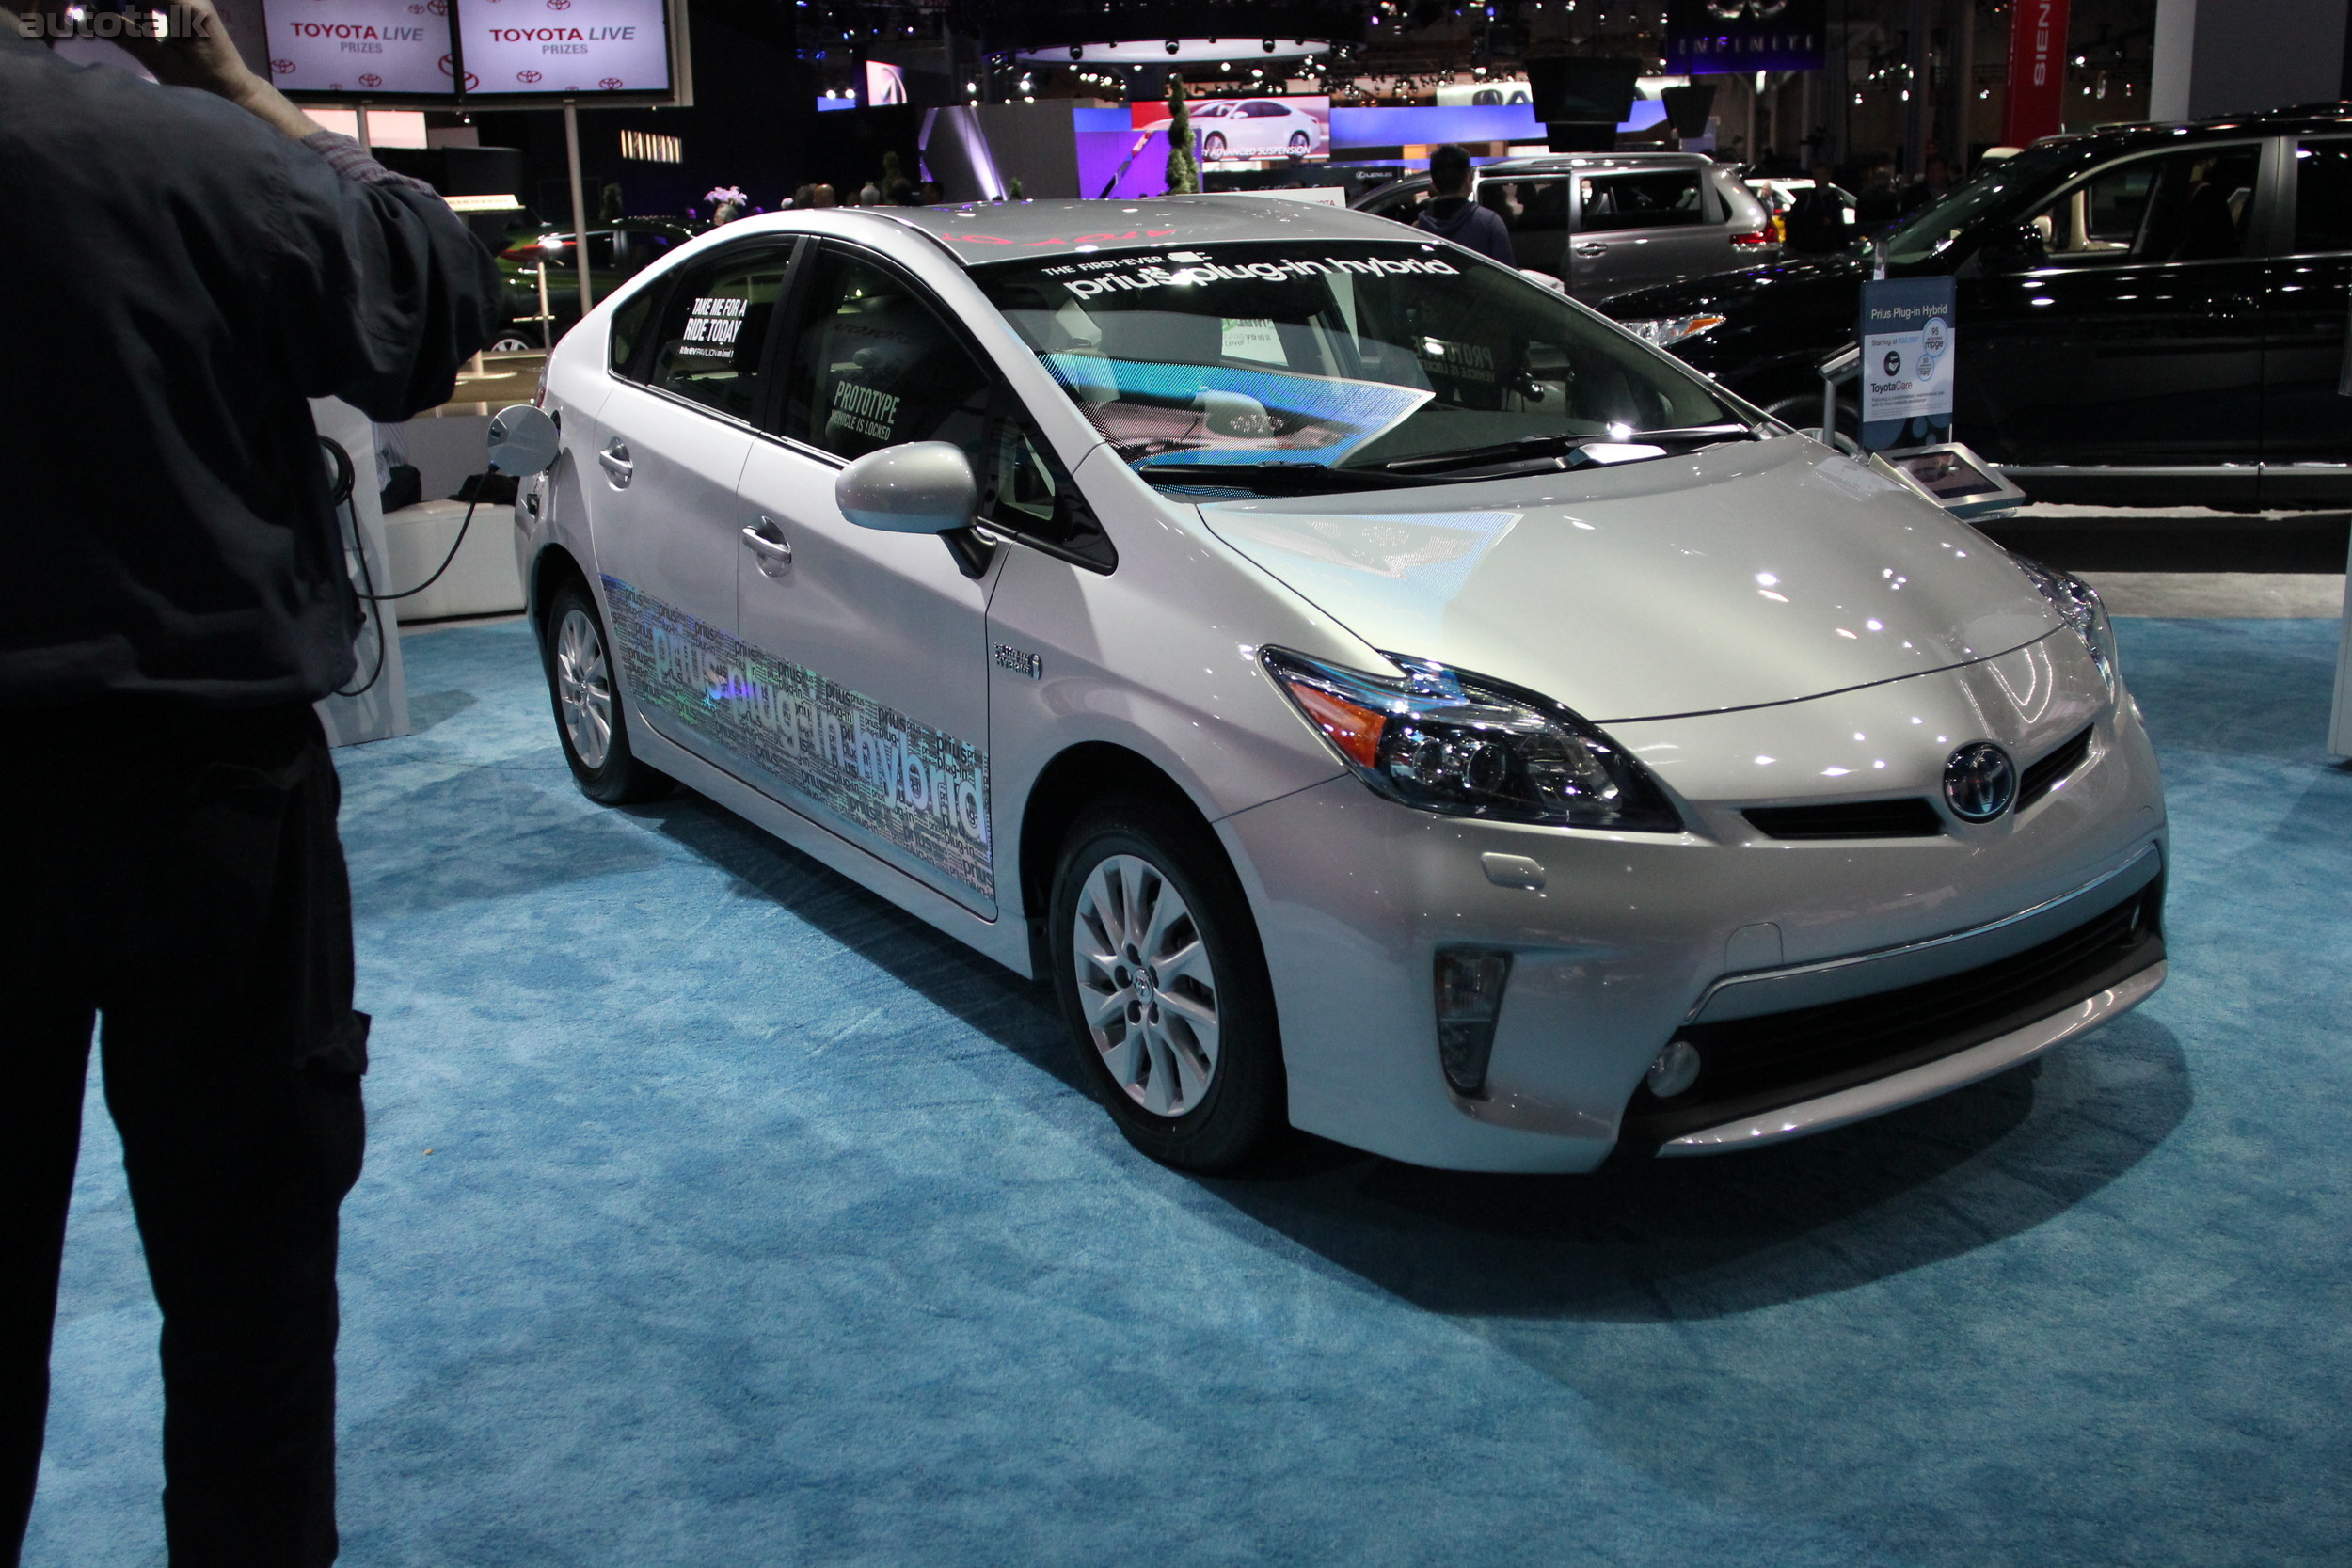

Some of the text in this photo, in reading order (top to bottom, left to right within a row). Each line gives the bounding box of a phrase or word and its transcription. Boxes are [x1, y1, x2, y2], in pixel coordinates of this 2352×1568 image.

[290, 23, 423, 41] TOYOTA LIVE
[489, 26, 636, 42] TOYOTA LIVE
[2033, 0, 2051, 86] SIEN
[340, 42, 383, 54] PRIZES
[542, 44, 588, 55] PRIZES
[1678, 33, 1813, 55] INFINITI
[1211, 147, 1257, 157] ADVANCED
[1257, 145, 1311, 156] SUSPENSION
[1041, 255, 1166, 277] THE FIRST-EVER
[1063, 257, 1460, 300] prius plug-in hybrid
[692, 298, 748, 317] TAKE ME FOR A
[1871, 304, 1947, 319] Prius Plug-in Hybrid
[683, 318, 742, 343] RIDE TODAY
[1871, 381, 1913, 394] ToyotaCare
[834, 380, 900, 425] PROTOTYPE
[832, 409, 891, 440] VEHICLE IS LOCKED
[694, 620, 714, 641] prius
[735, 640, 755, 661] prius
[778, 661, 802, 684] prius
[825, 682, 851, 706] prius
[826, 703, 853, 724] plug-in
[878, 706, 907, 731] prius
[652, 623, 987, 844] prius plug-in hybrid
[937, 736, 967, 764] prius
[937, 756, 968, 780] plug-in
[801, 770, 826, 793] prius
[849, 799, 876, 820] prius
[903, 826, 933, 851] prius
[945, 832, 975, 857] plug-in
[962, 859, 993, 888] prius
